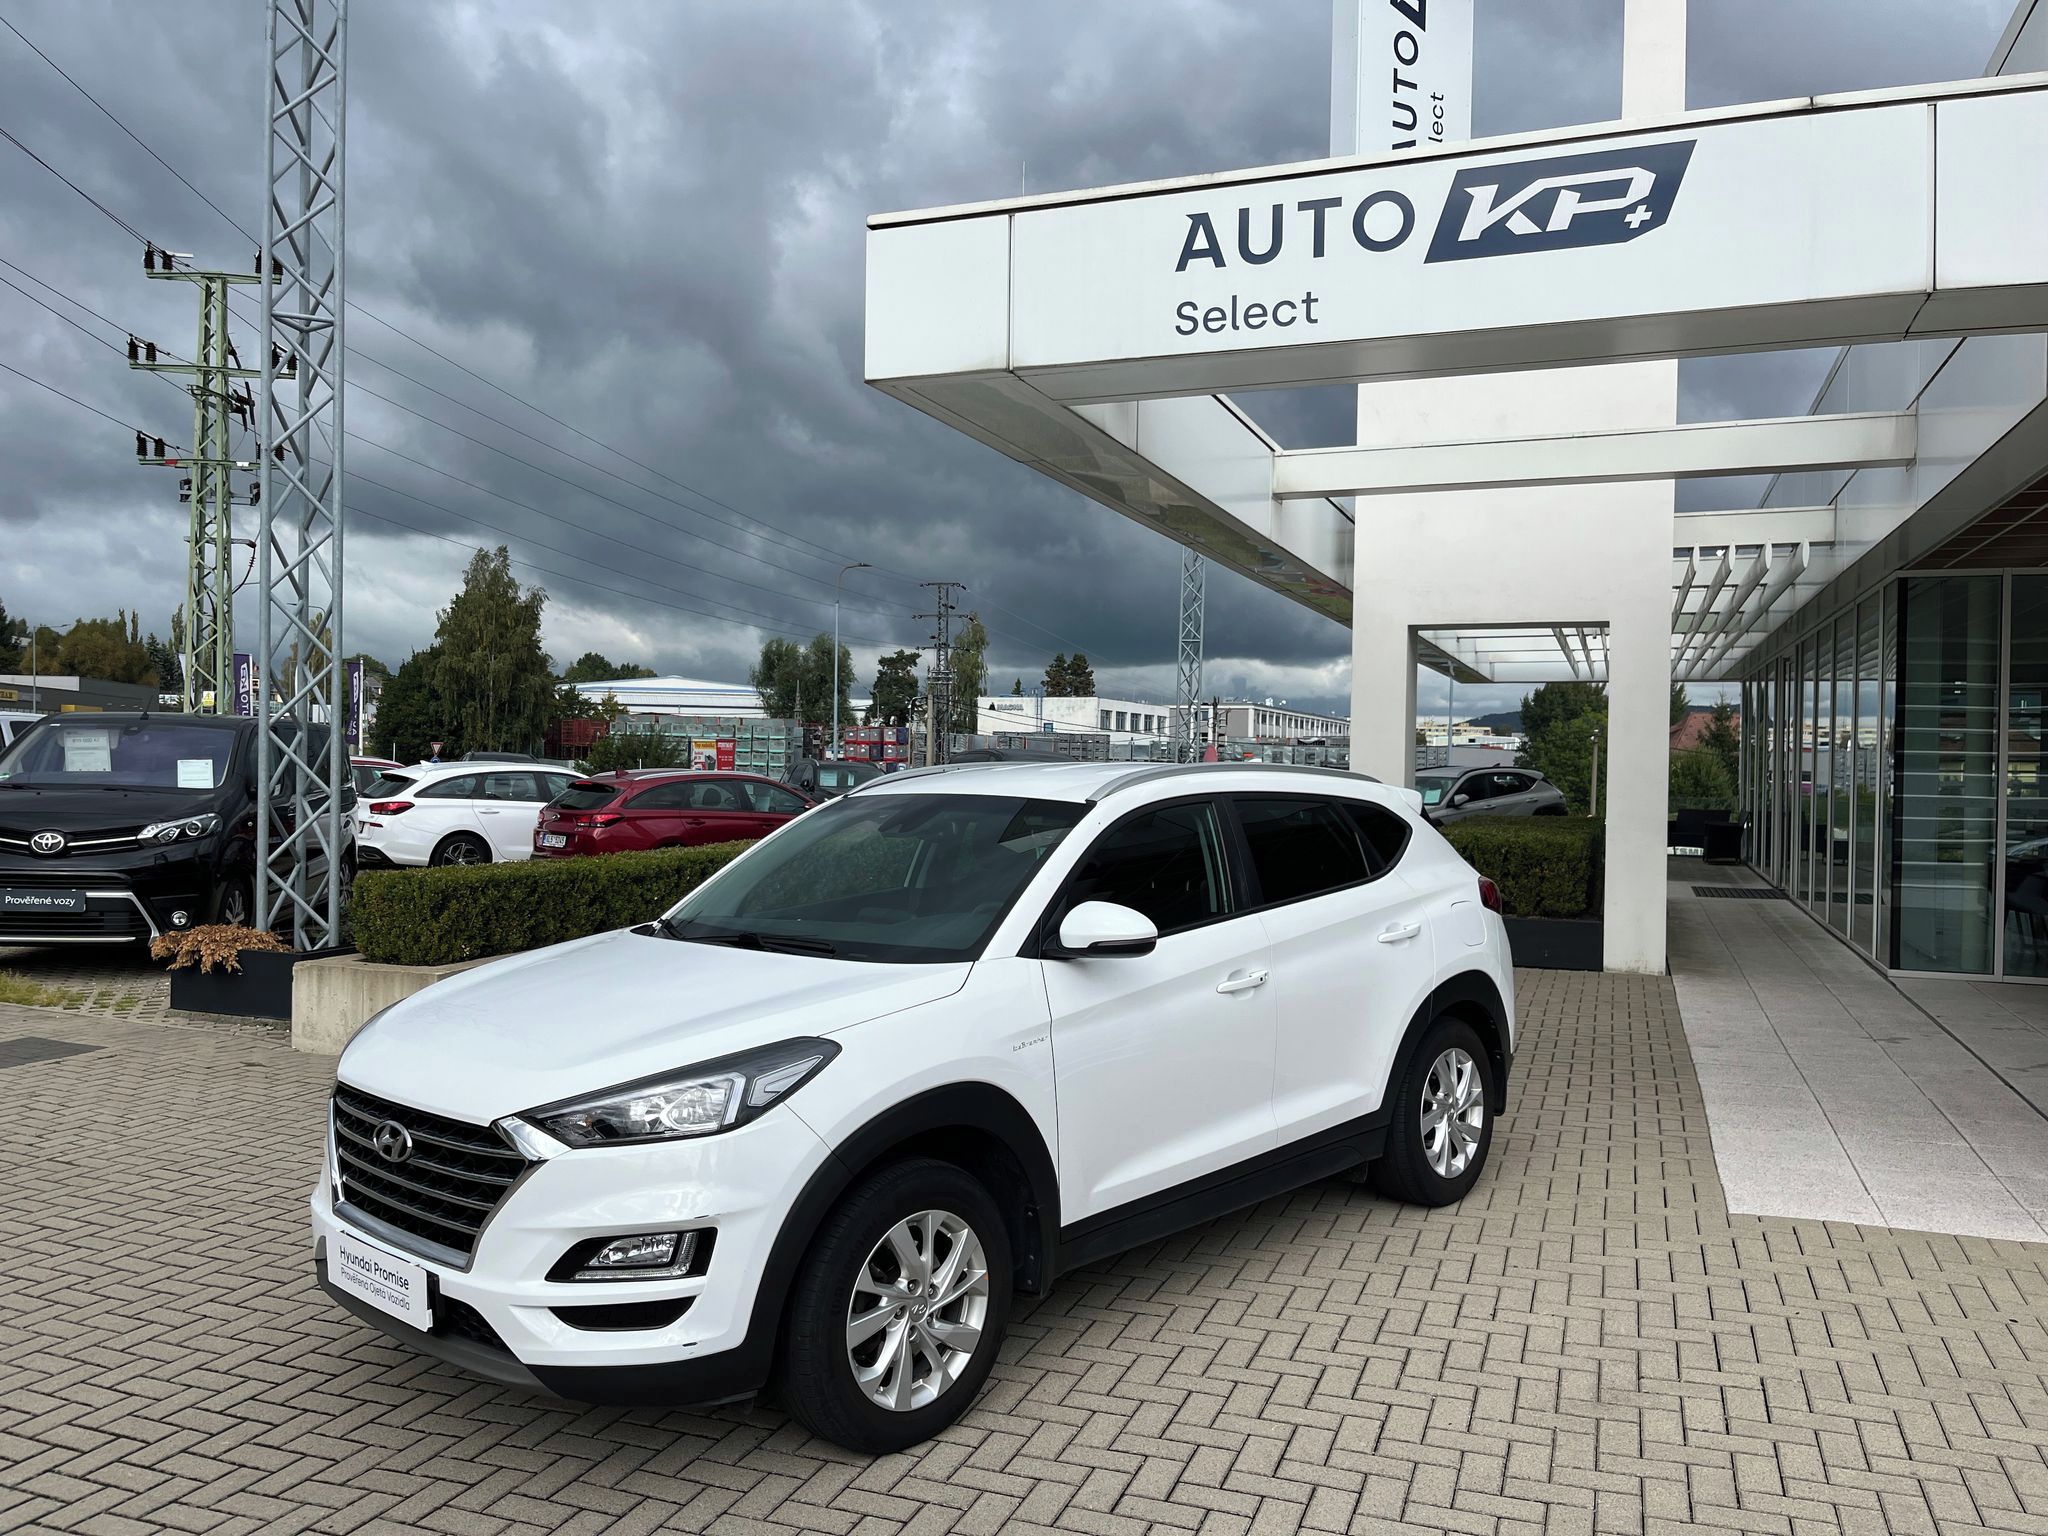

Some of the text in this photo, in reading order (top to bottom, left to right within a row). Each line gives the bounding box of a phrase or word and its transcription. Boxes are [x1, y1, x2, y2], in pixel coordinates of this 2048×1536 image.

[1428, 92, 1444, 143] lect
[1175, 190, 1416, 272] AUTO
[1175, 291, 1319, 336] Select
[5, 895, 76, 907] Prověřené vozy
[339, 1245, 409, 1290] Hyundai Promise
[386, 1290, 410, 1311] Vozidla
